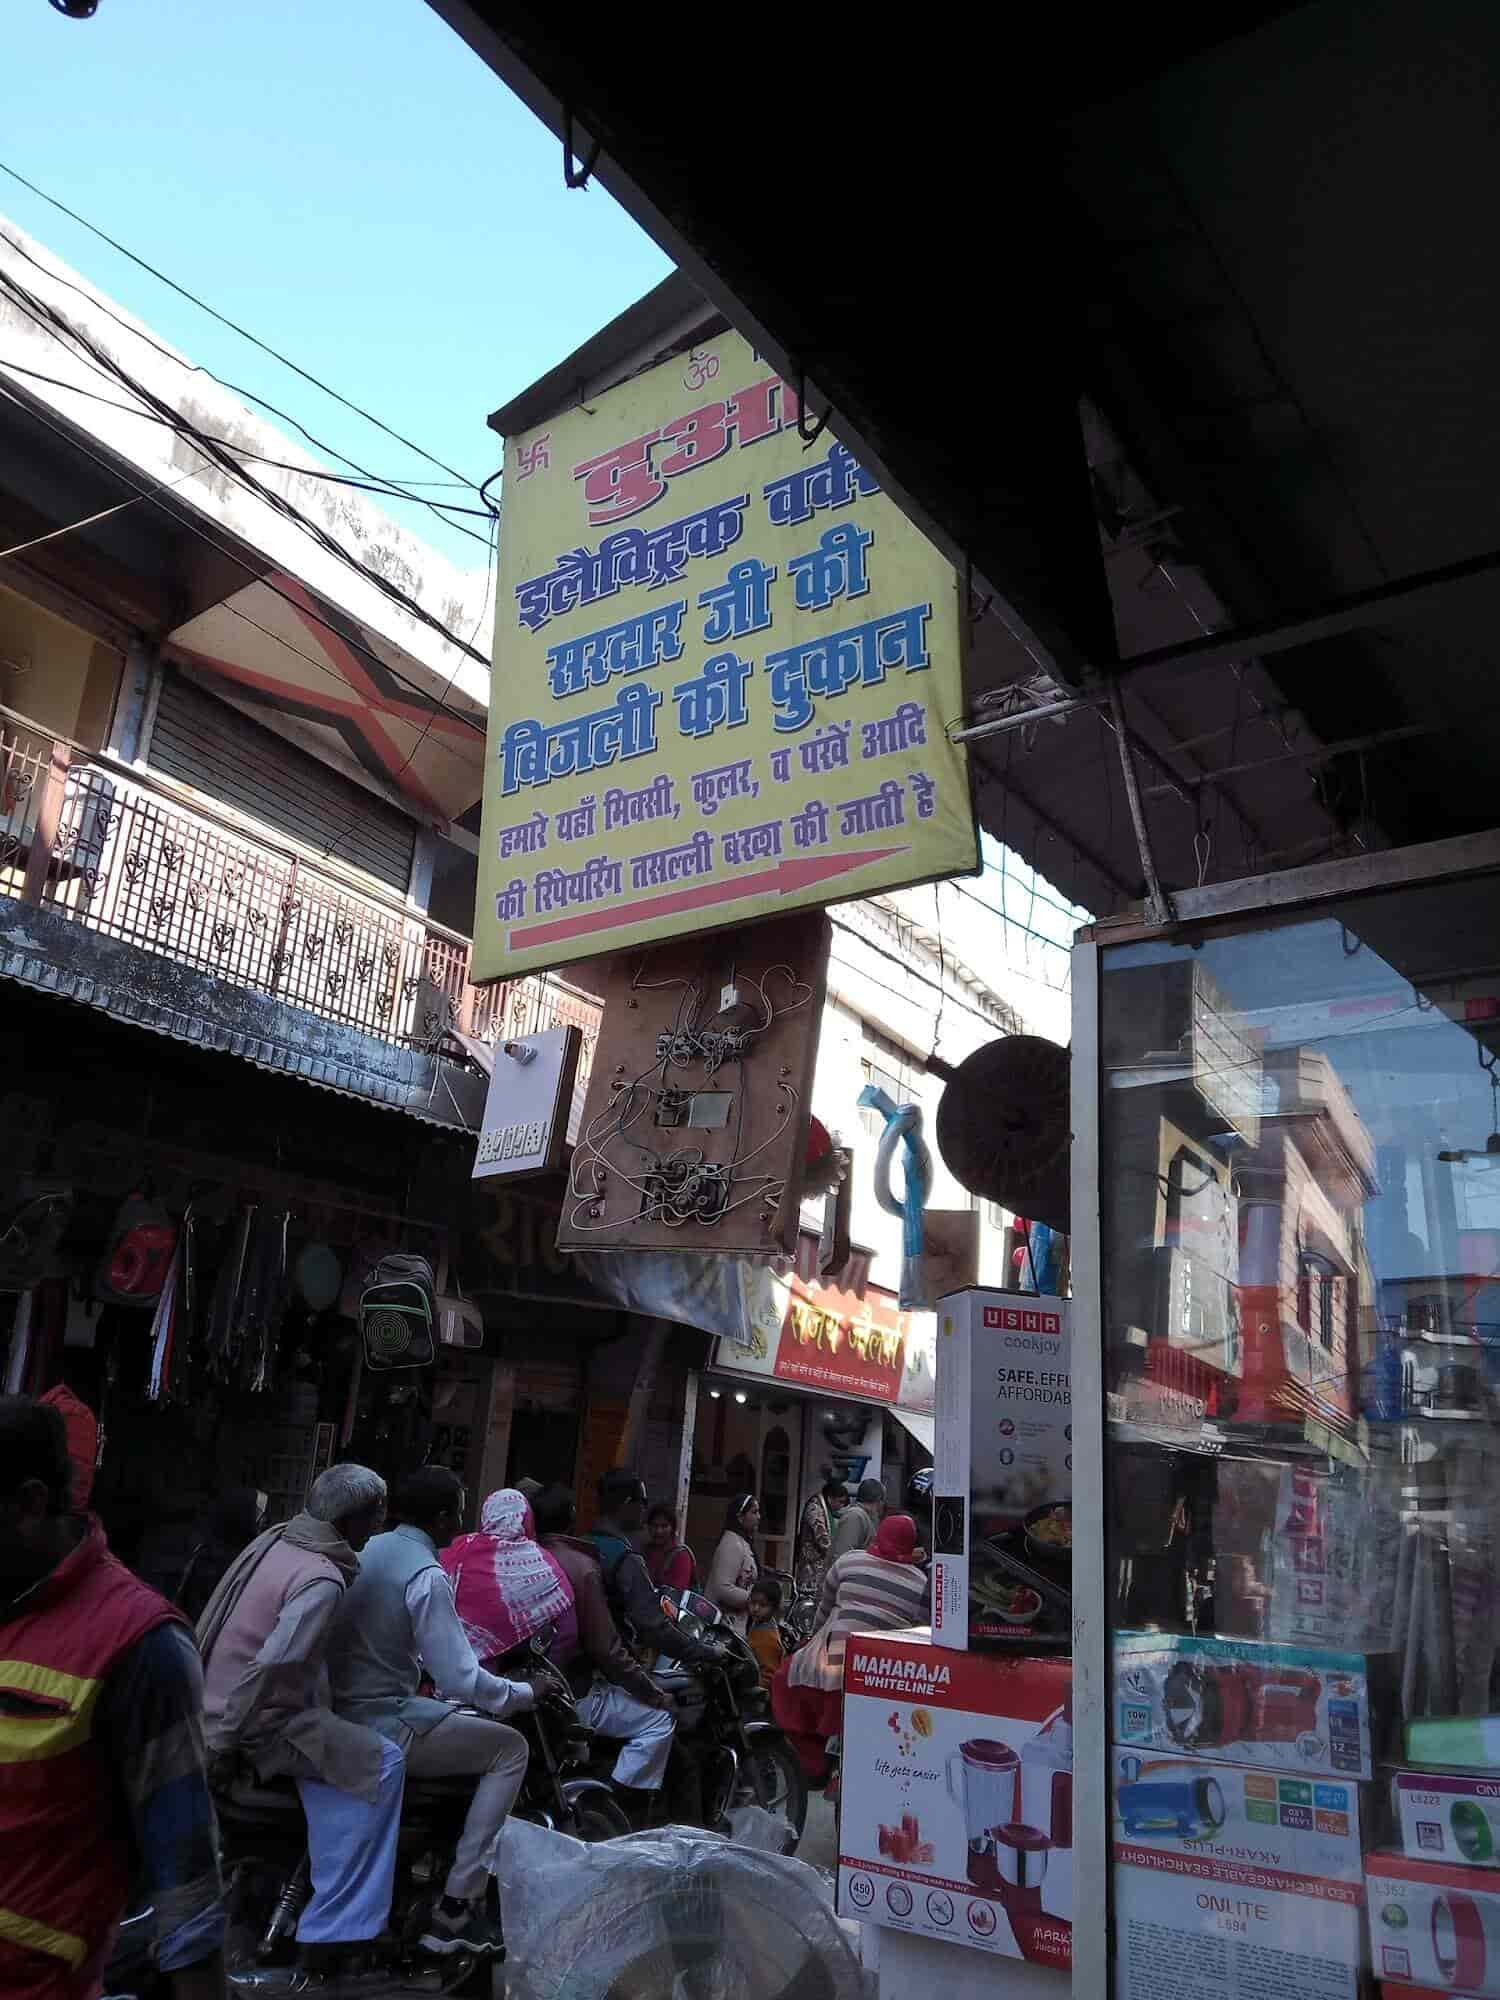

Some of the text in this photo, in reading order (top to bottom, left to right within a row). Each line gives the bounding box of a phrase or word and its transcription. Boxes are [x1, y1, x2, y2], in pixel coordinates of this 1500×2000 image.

[546, 522, 873, 699] सरदार जी की
[500, 603, 931, 796] बिजली की दुकान
[499, 811, 549, 859] हमारे
[770, 748, 792, 783] व
[860, 701, 928, 759] आदि
[495, 878, 527, 921] की
[629, 830, 714, 889] तसल्ली
[790, 799, 830, 849] की
[836, 779, 905, 836] जाती
[907, 771, 936, 819] है
[985, 1309, 1058, 1332] USHA
[998, 1385, 1072, 1405] AFFORDAB
[852, 1653, 951, 1685] MAHARAJA
[864, 1674, 936, 1696] WHITELINE
[1475, 1784, 1500, 1797] ON
[1121, 1850, 1210, 1875] SEARCHLIGHT
[1183, 1839, 1281, 1866] AKARI-PLUS
[853, 1882, 870, 1895] 450
[1213, 1864, 1325, 1898] RECHARGEABLE
[1328, 1886, 1356, 1902] LED
[1196, 1894, 1271, 1922] ONLITE
[1032, 1927, 1072, 1945] MARK
